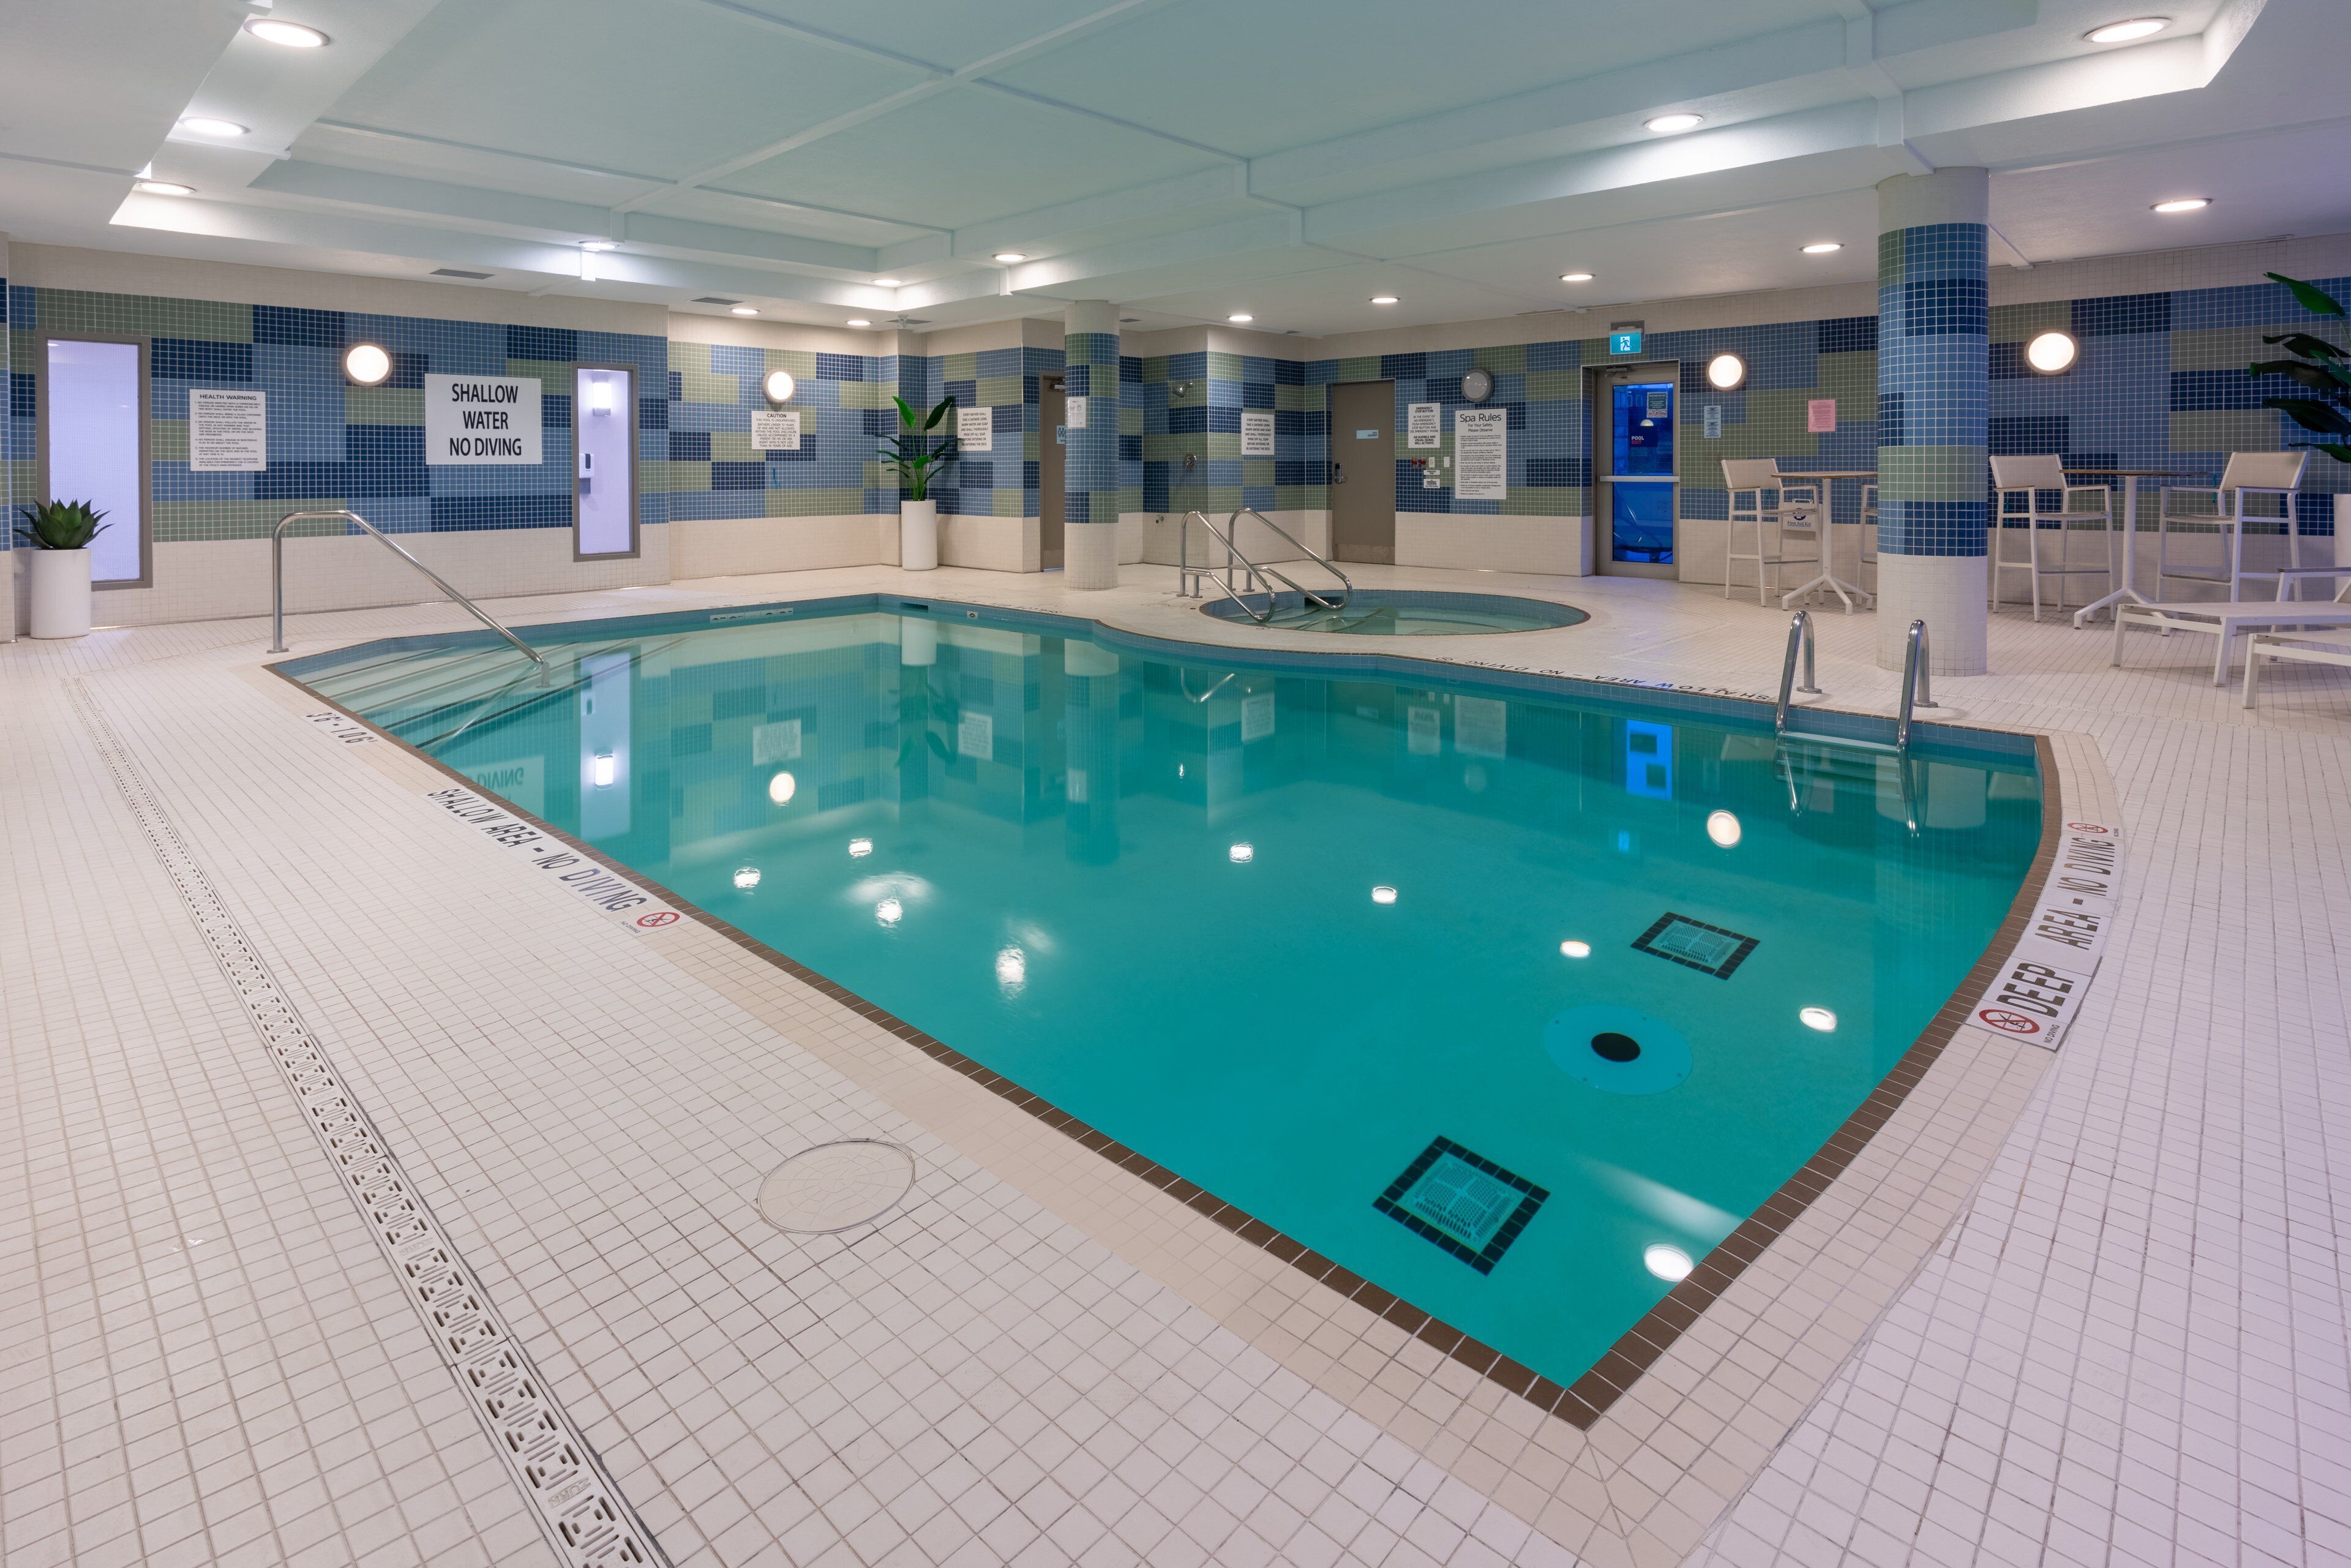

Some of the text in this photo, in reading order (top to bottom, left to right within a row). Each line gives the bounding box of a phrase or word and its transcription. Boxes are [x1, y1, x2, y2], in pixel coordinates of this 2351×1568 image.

[452, 383, 518, 403] SHALLOW
[463, 411, 508, 429] WATER
[1460, 412, 1502, 423] Spa Rules
[449, 438, 522, 456] NO DIVING
[1464, 661, 1529, 671] DIVING
[1654, 682, 1769, 700] SHALLOW
[427, 788, 508, 825] SHALLOW
[481, 822, 543, 848] AREA
[532, 852, 580, 869] NO
[558, 868, 648, 912] DIVING
[2063, 838, 2115, 876] DIVING
[2057, 877, 2109, 896] NO
[626, 925, 641, 934] DIVING
[2034, 909, 2101, 950] AREA
[1996, 962, 2075, 1018] DEEP
[2043, 1024, 2060, 1044] NO DIVING
